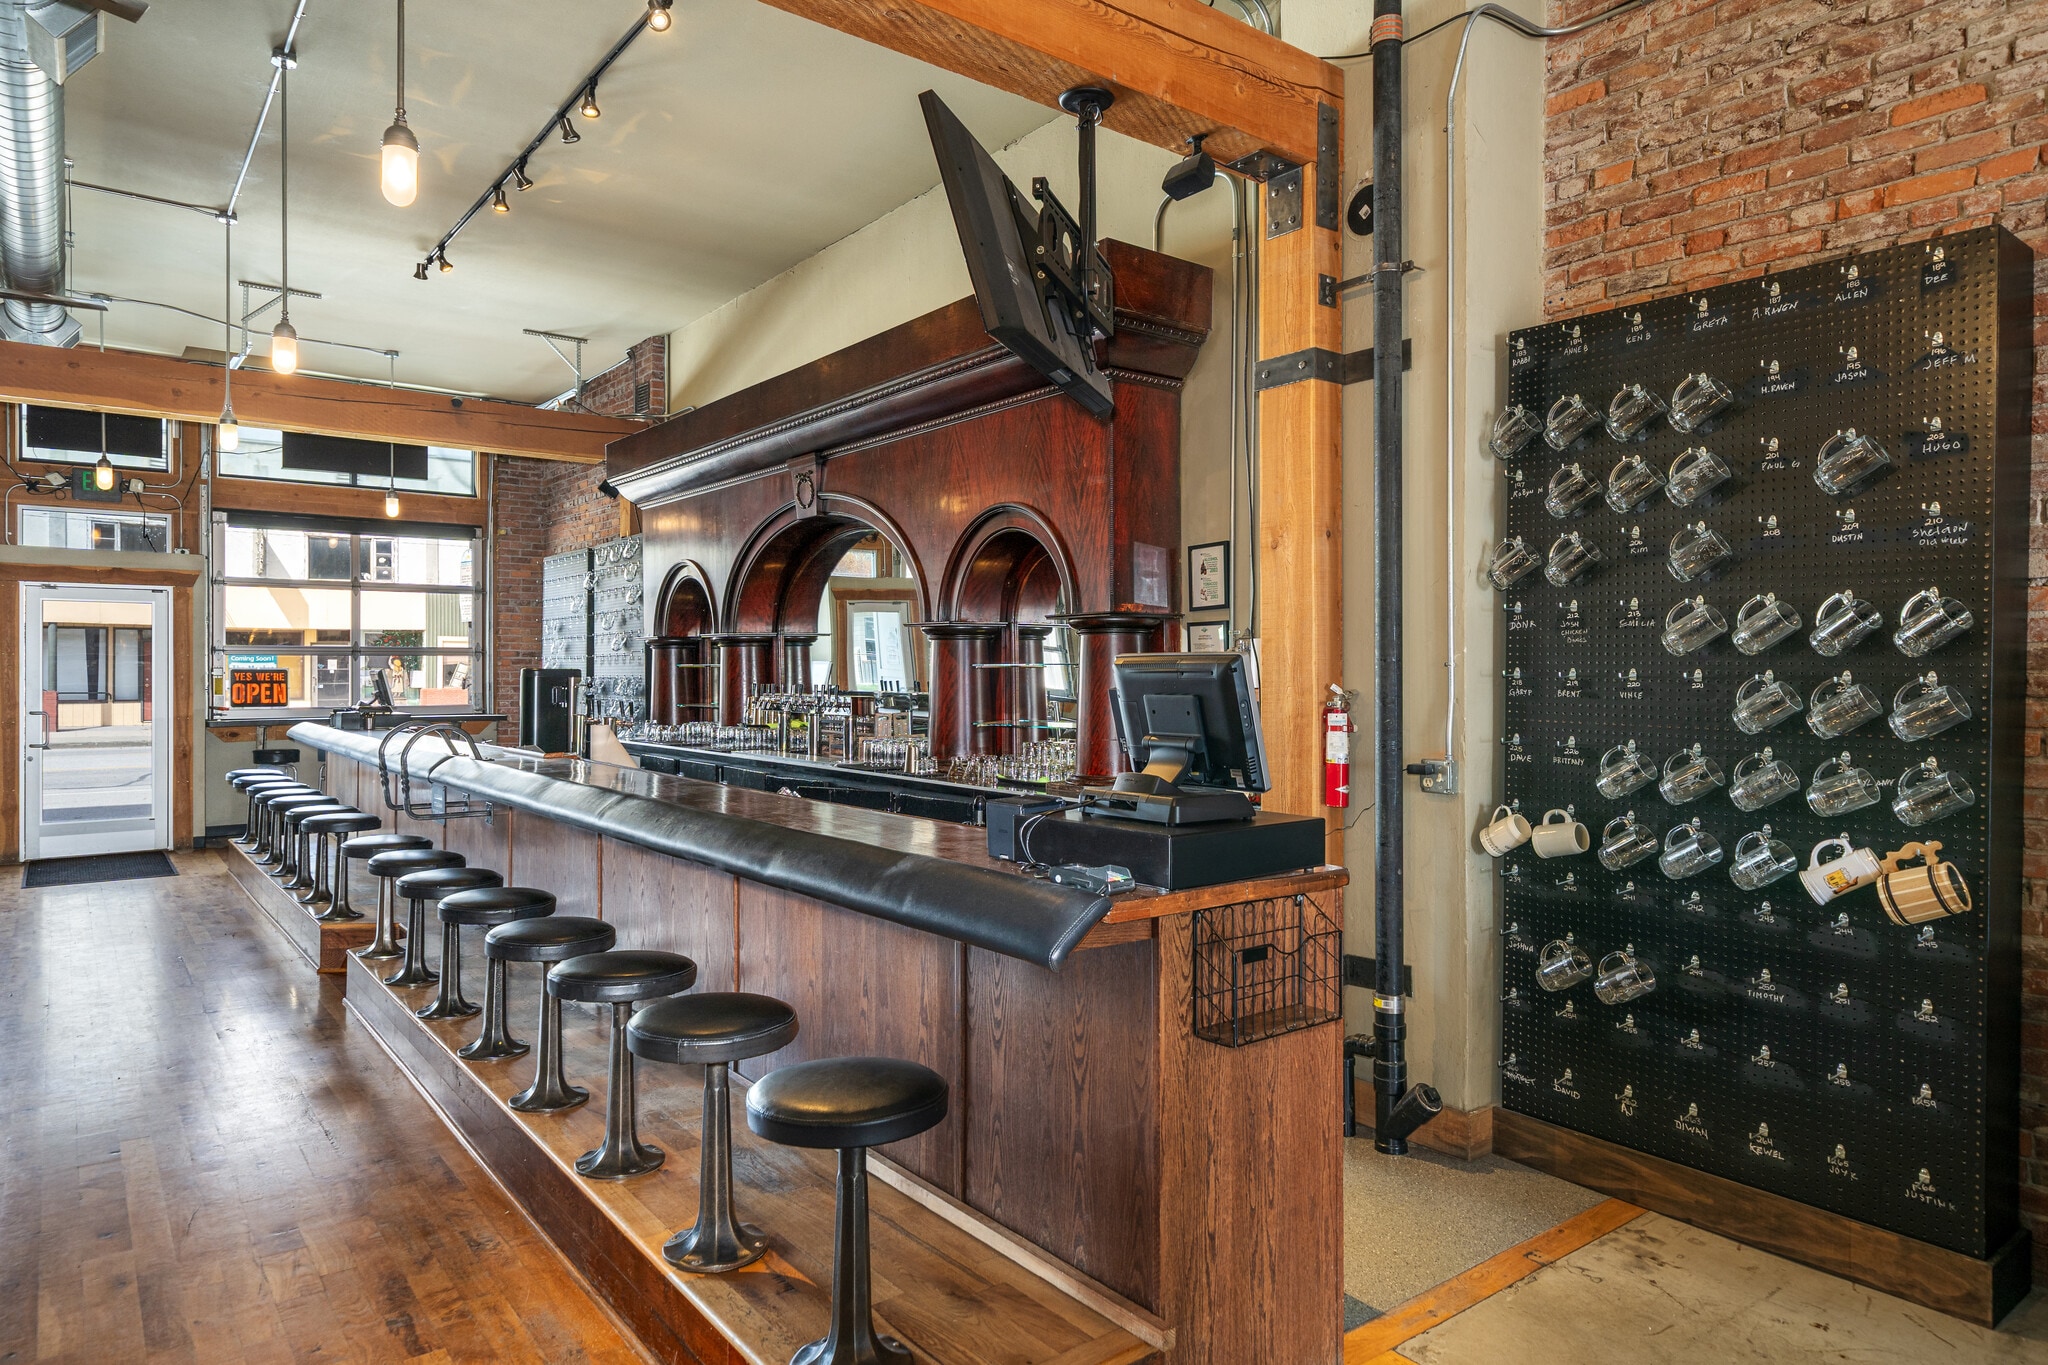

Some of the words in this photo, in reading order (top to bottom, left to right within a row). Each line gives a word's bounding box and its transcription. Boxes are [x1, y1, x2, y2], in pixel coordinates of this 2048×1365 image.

[1932, 263, 1946, 272] 189
[1925, 273, 1948, 285] DEE
[1846, 280, 1860, 288] 188
[1834, 288, 1868, 302] ALLEN
[1769, 296, 1781, 304] 187
[1693, 316, 1728, 331] GRETA
[1631, 325, 1644, 333] 185
[1570, 338, 1583, 346] 184
[1626, 335, 1643, 344] KEN
[1563, 346, 1582, 355] ANNE
[1846, 362, 1861, 370] 195
[1923, 355, 1958, 370] JEFF
[1964, 354, 1976, 363] M
[1926, 433, 1945, 441] 203
[1922, 441, 1961, 454] HUGO
[1765, 452, 1779, 460] 201
[1924, 518, 1943, 526] 210
[1841, 523, 1859, 531] 209
[1763, 529, 1781, 537] 208
[230, 655, 255, 663] Coming
[234, 672, 253, 681] YES
[255, 672, 285, 681] WE'RE
[232, 683, 287, 704] OPEN
[1558, 690, 1582, 698] BRENT
[1509, 875, 1521, 883] 239
[1687, 904, 1704, 912] 242
[1758, 915, 1775, 923] 243
[1835, 928, 1853, 936] 244
[1918, 941, 1938, 949] 245
[1758, 983, 1776, 991] 250
[1747, 990, 1785, 1003] TIMOTHY
[1919, 1015, 1939, 1023] 252
[1686, 1042, 1703, 1050] 256
[1757, 1059, 1775, 1068] 257
[1833, 1078, 1851, 1087] 258
[1553, 1083, 1581, 1099] DAVID
[1917, 1099, 1937, 1108] 259
[1756, 1135, 1774, 1146] 264
